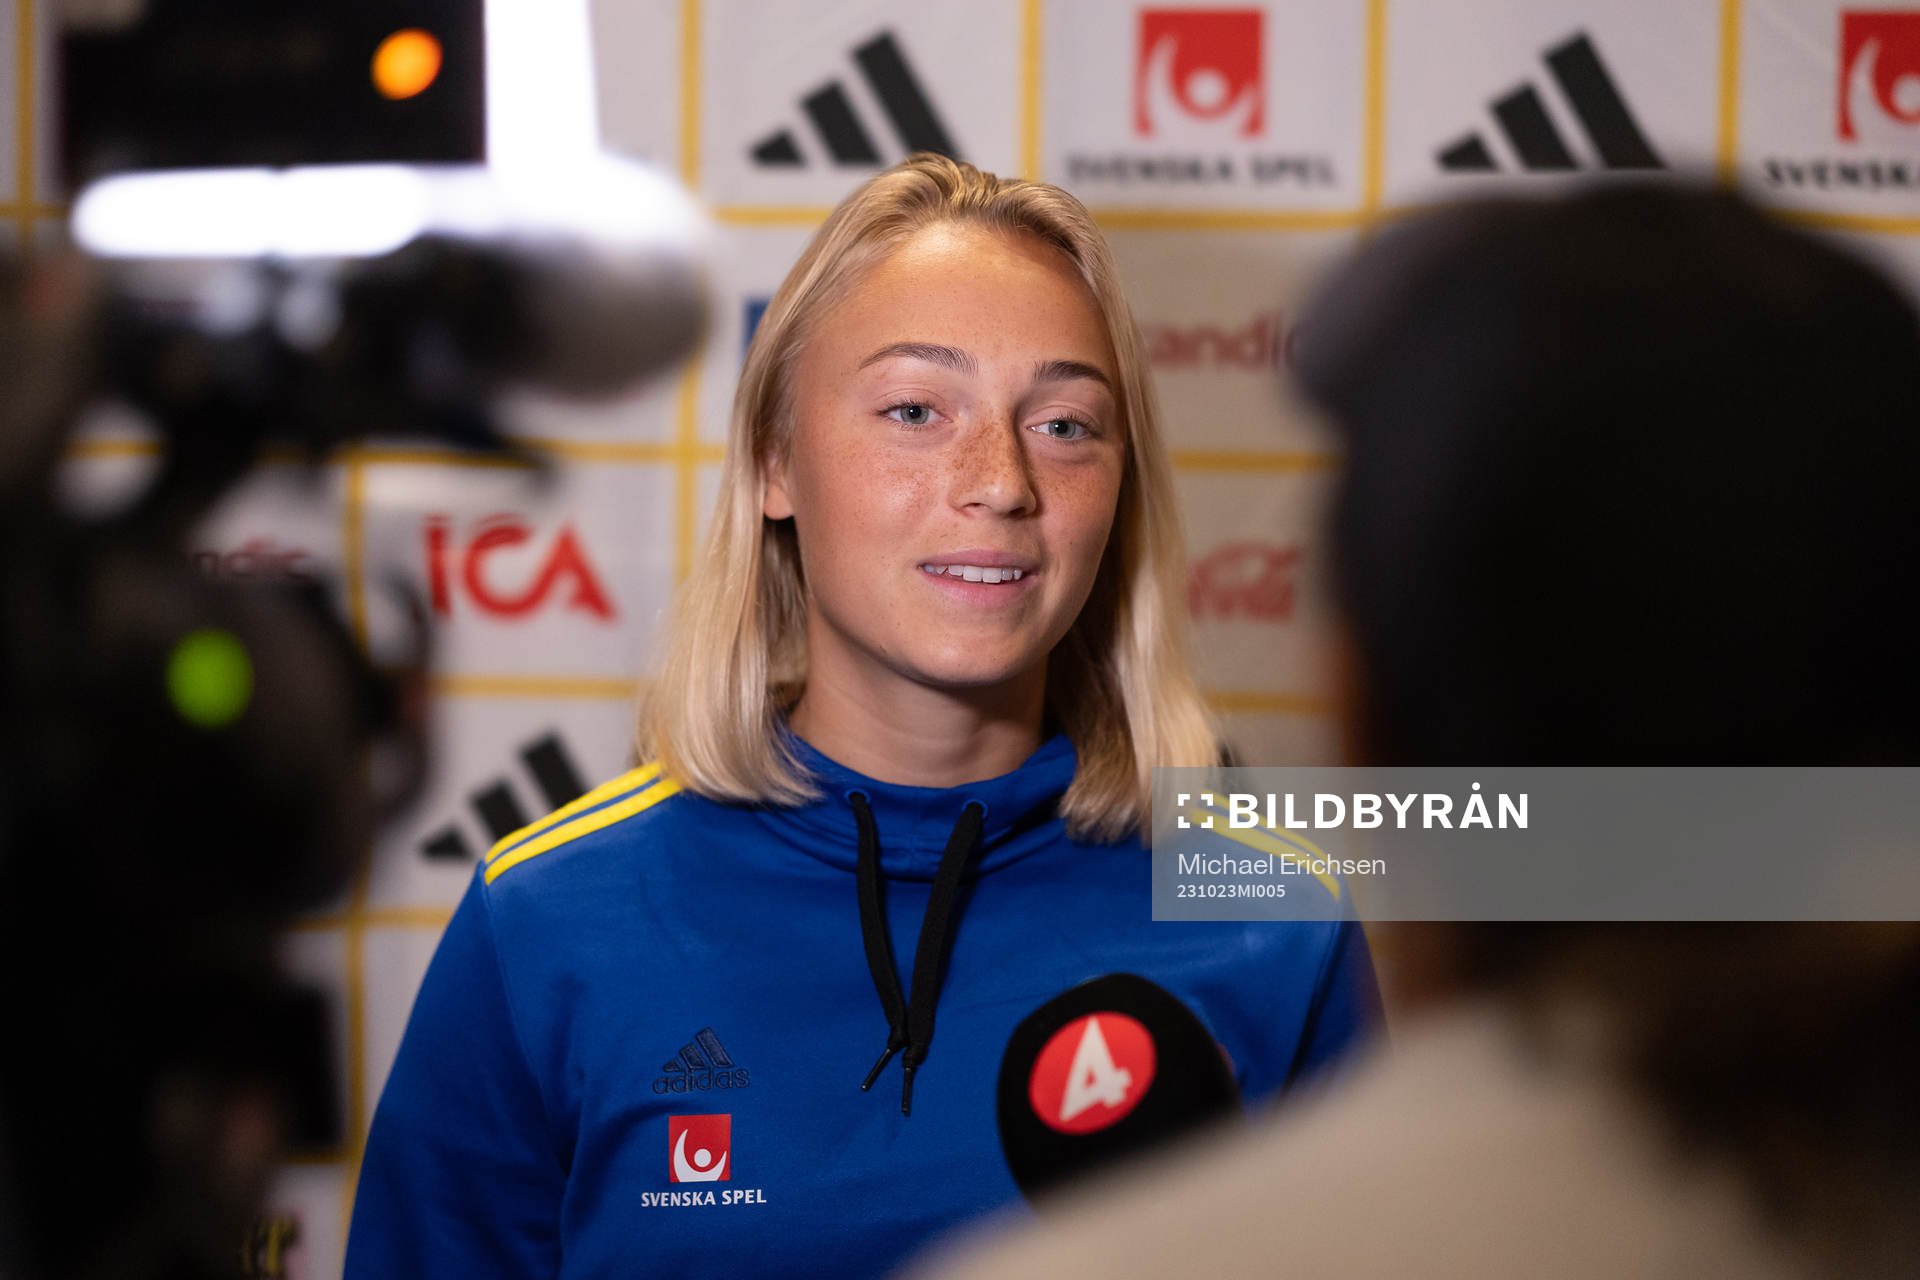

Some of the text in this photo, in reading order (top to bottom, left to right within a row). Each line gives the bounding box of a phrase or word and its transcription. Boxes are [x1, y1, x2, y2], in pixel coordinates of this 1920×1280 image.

[1067, 153, 1335, 188] SVENSKA SPEL
[424, 513, 616, 626] ICA
[653, 1067, 750, 1094] adidas
[641, 1188, 767, 1207] SVENSKA SPEL
